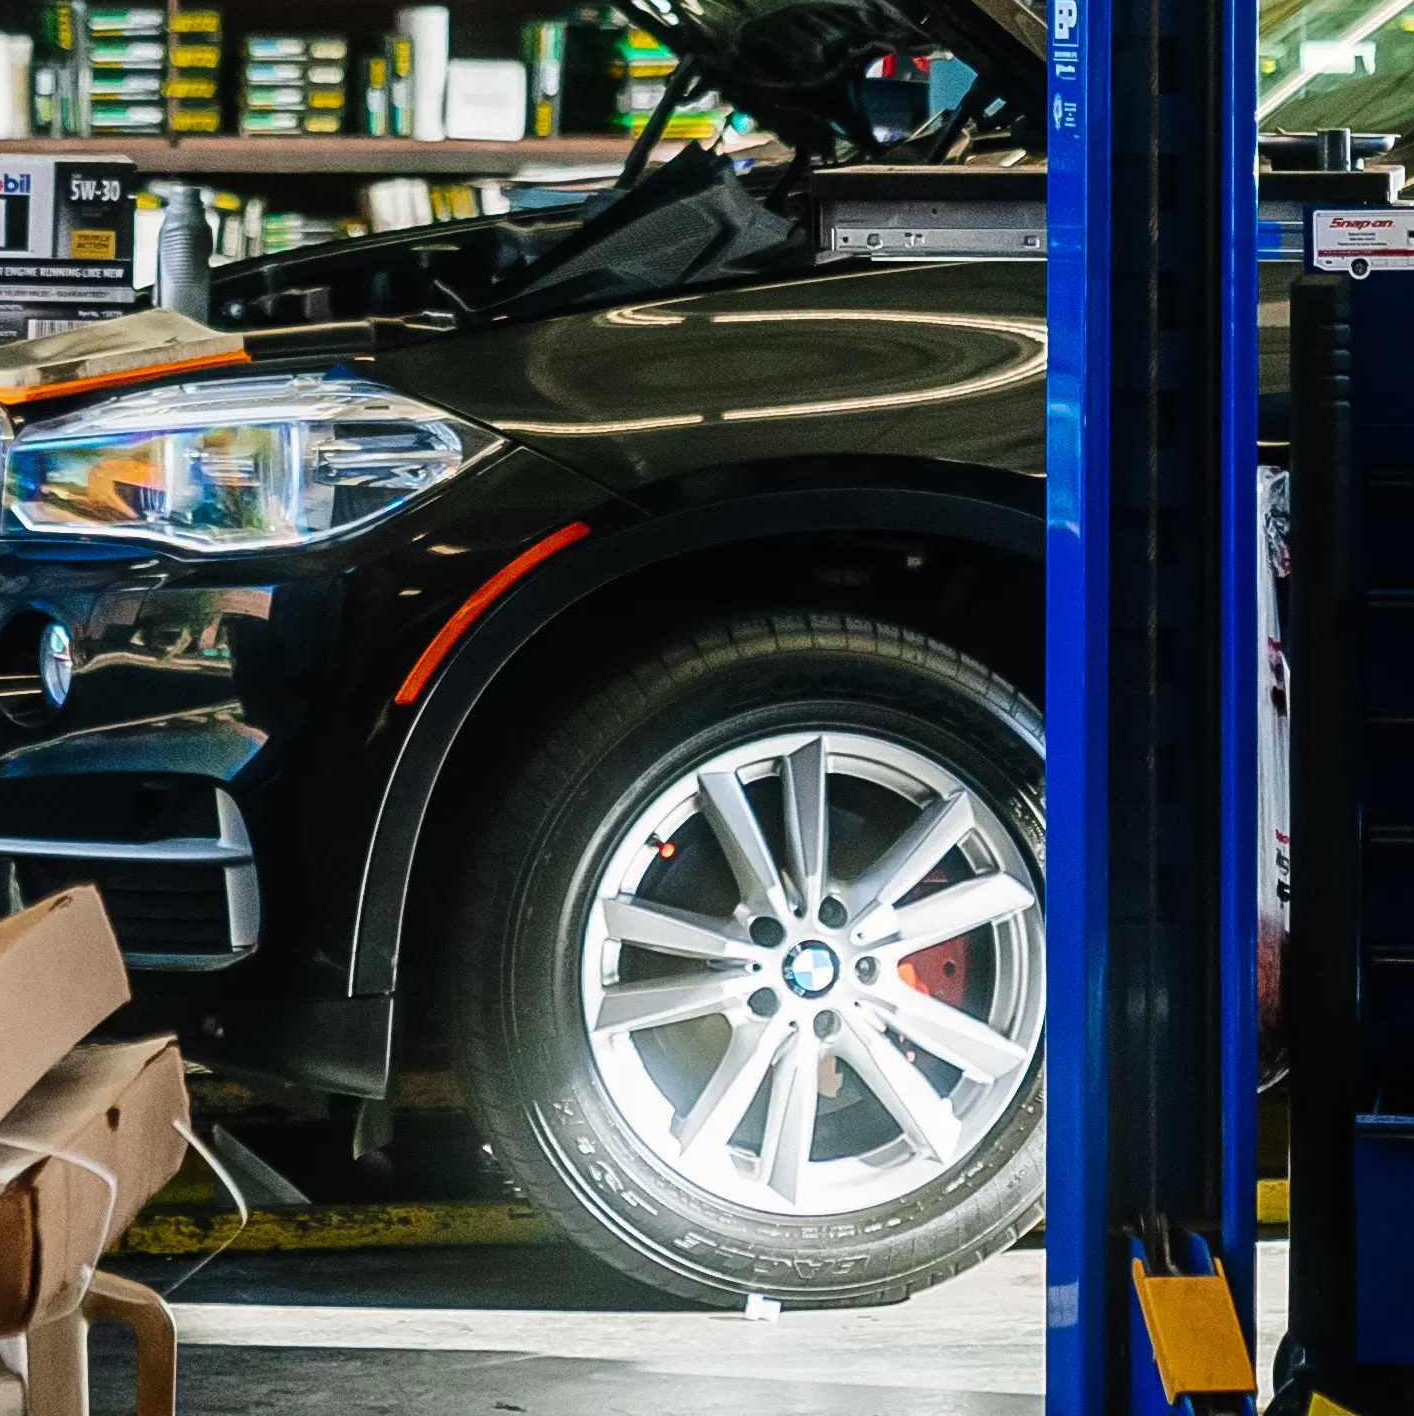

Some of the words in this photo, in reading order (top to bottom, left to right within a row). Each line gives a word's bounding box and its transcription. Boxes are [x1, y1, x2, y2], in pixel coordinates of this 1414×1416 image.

[70, 179, 121, 201] 5W-30
[1329, 217, 1394, 230] Snap-on
[75, 242, 110, 250] ACTION
[5, 266, 36, 278] ENGINE
[39, 267, 81, 278] RUNNING
[103, 268, 124, 279] NEW
